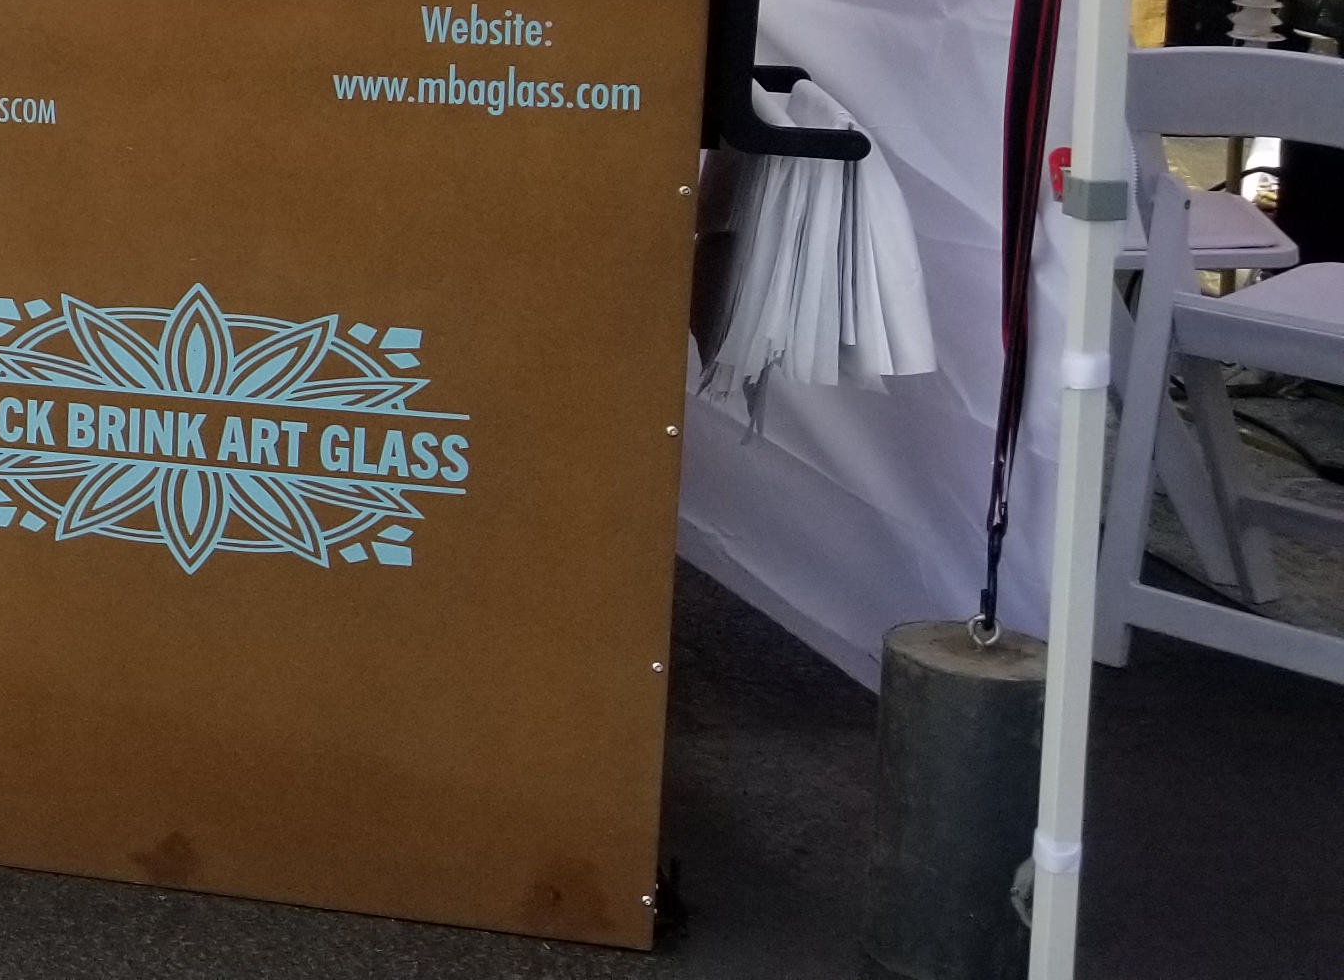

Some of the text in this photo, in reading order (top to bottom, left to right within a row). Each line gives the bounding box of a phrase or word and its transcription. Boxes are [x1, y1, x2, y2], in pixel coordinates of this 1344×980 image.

[421, 3, 553, 47] Website:
[332, 63, 641, 116] www.mbaglass.com
[66, 402, 207, 460] BRINK
[216, 415, 308, 468] ART
[319, 423, 470, 483] GLASS
